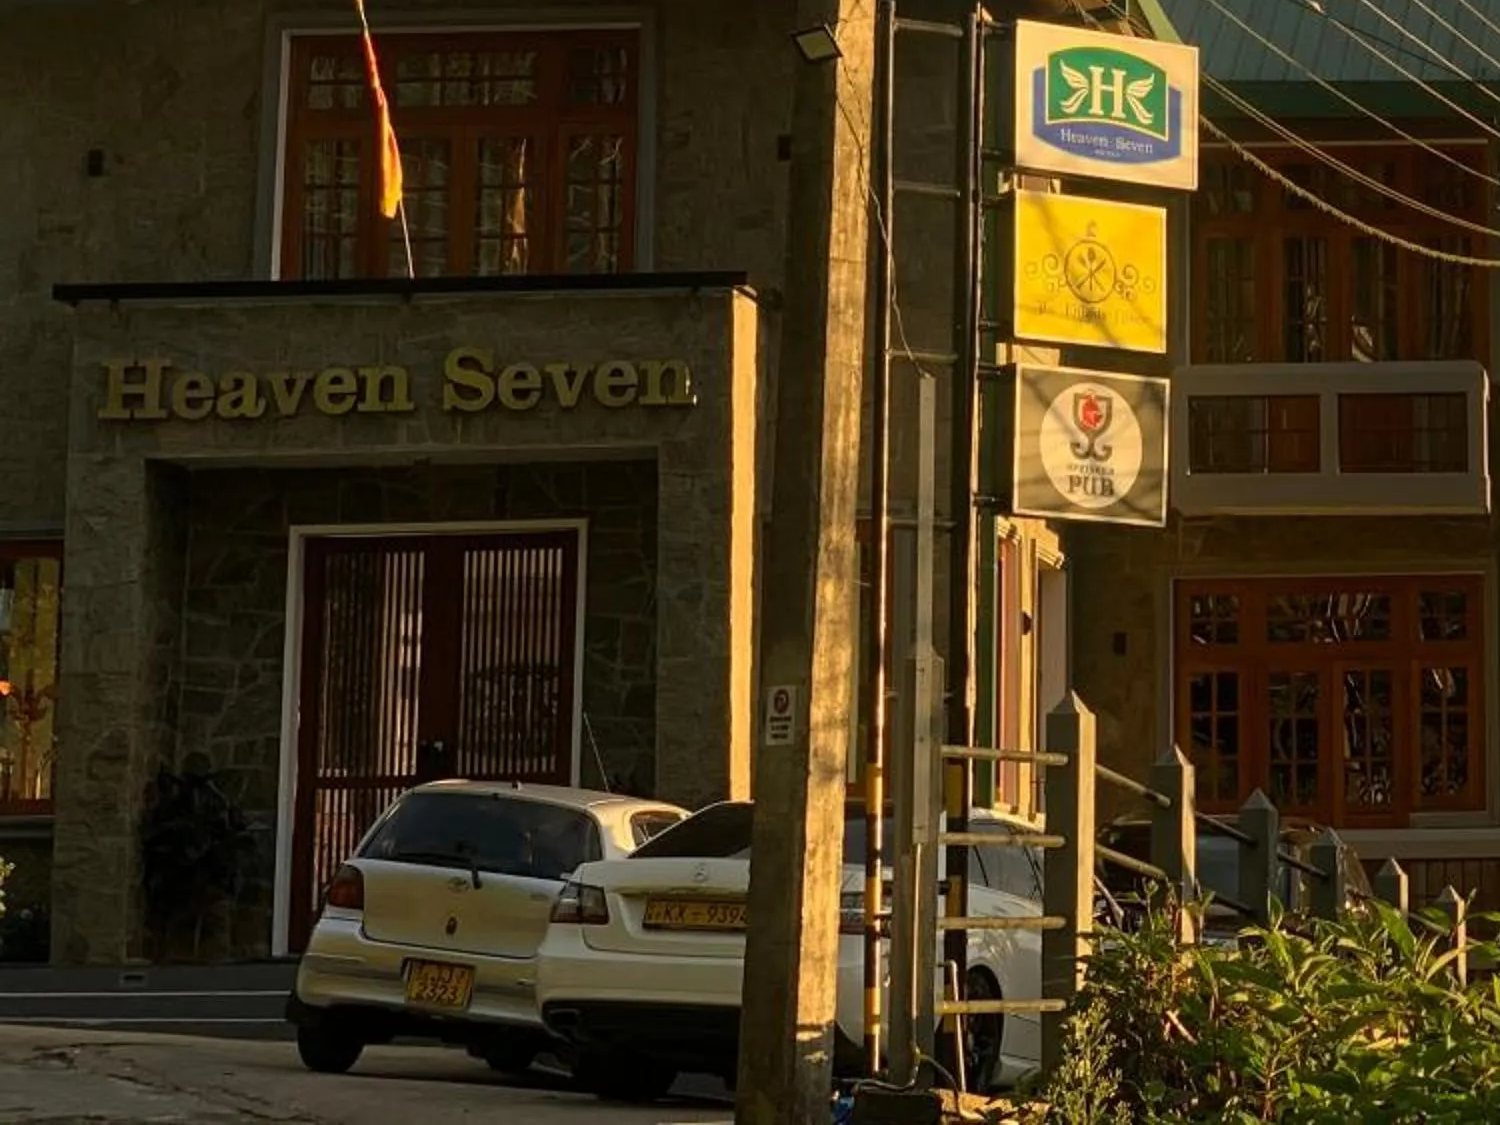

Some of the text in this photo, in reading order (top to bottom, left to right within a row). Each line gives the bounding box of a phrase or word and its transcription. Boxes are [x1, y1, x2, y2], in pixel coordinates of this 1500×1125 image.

[1060, 127, 1109, 148] Heaven
[1115, 136, 1153, 154] Seven
[98, 347, 695, 420] Heaven Seven
[1065, 474, 1115, 497] PUB
